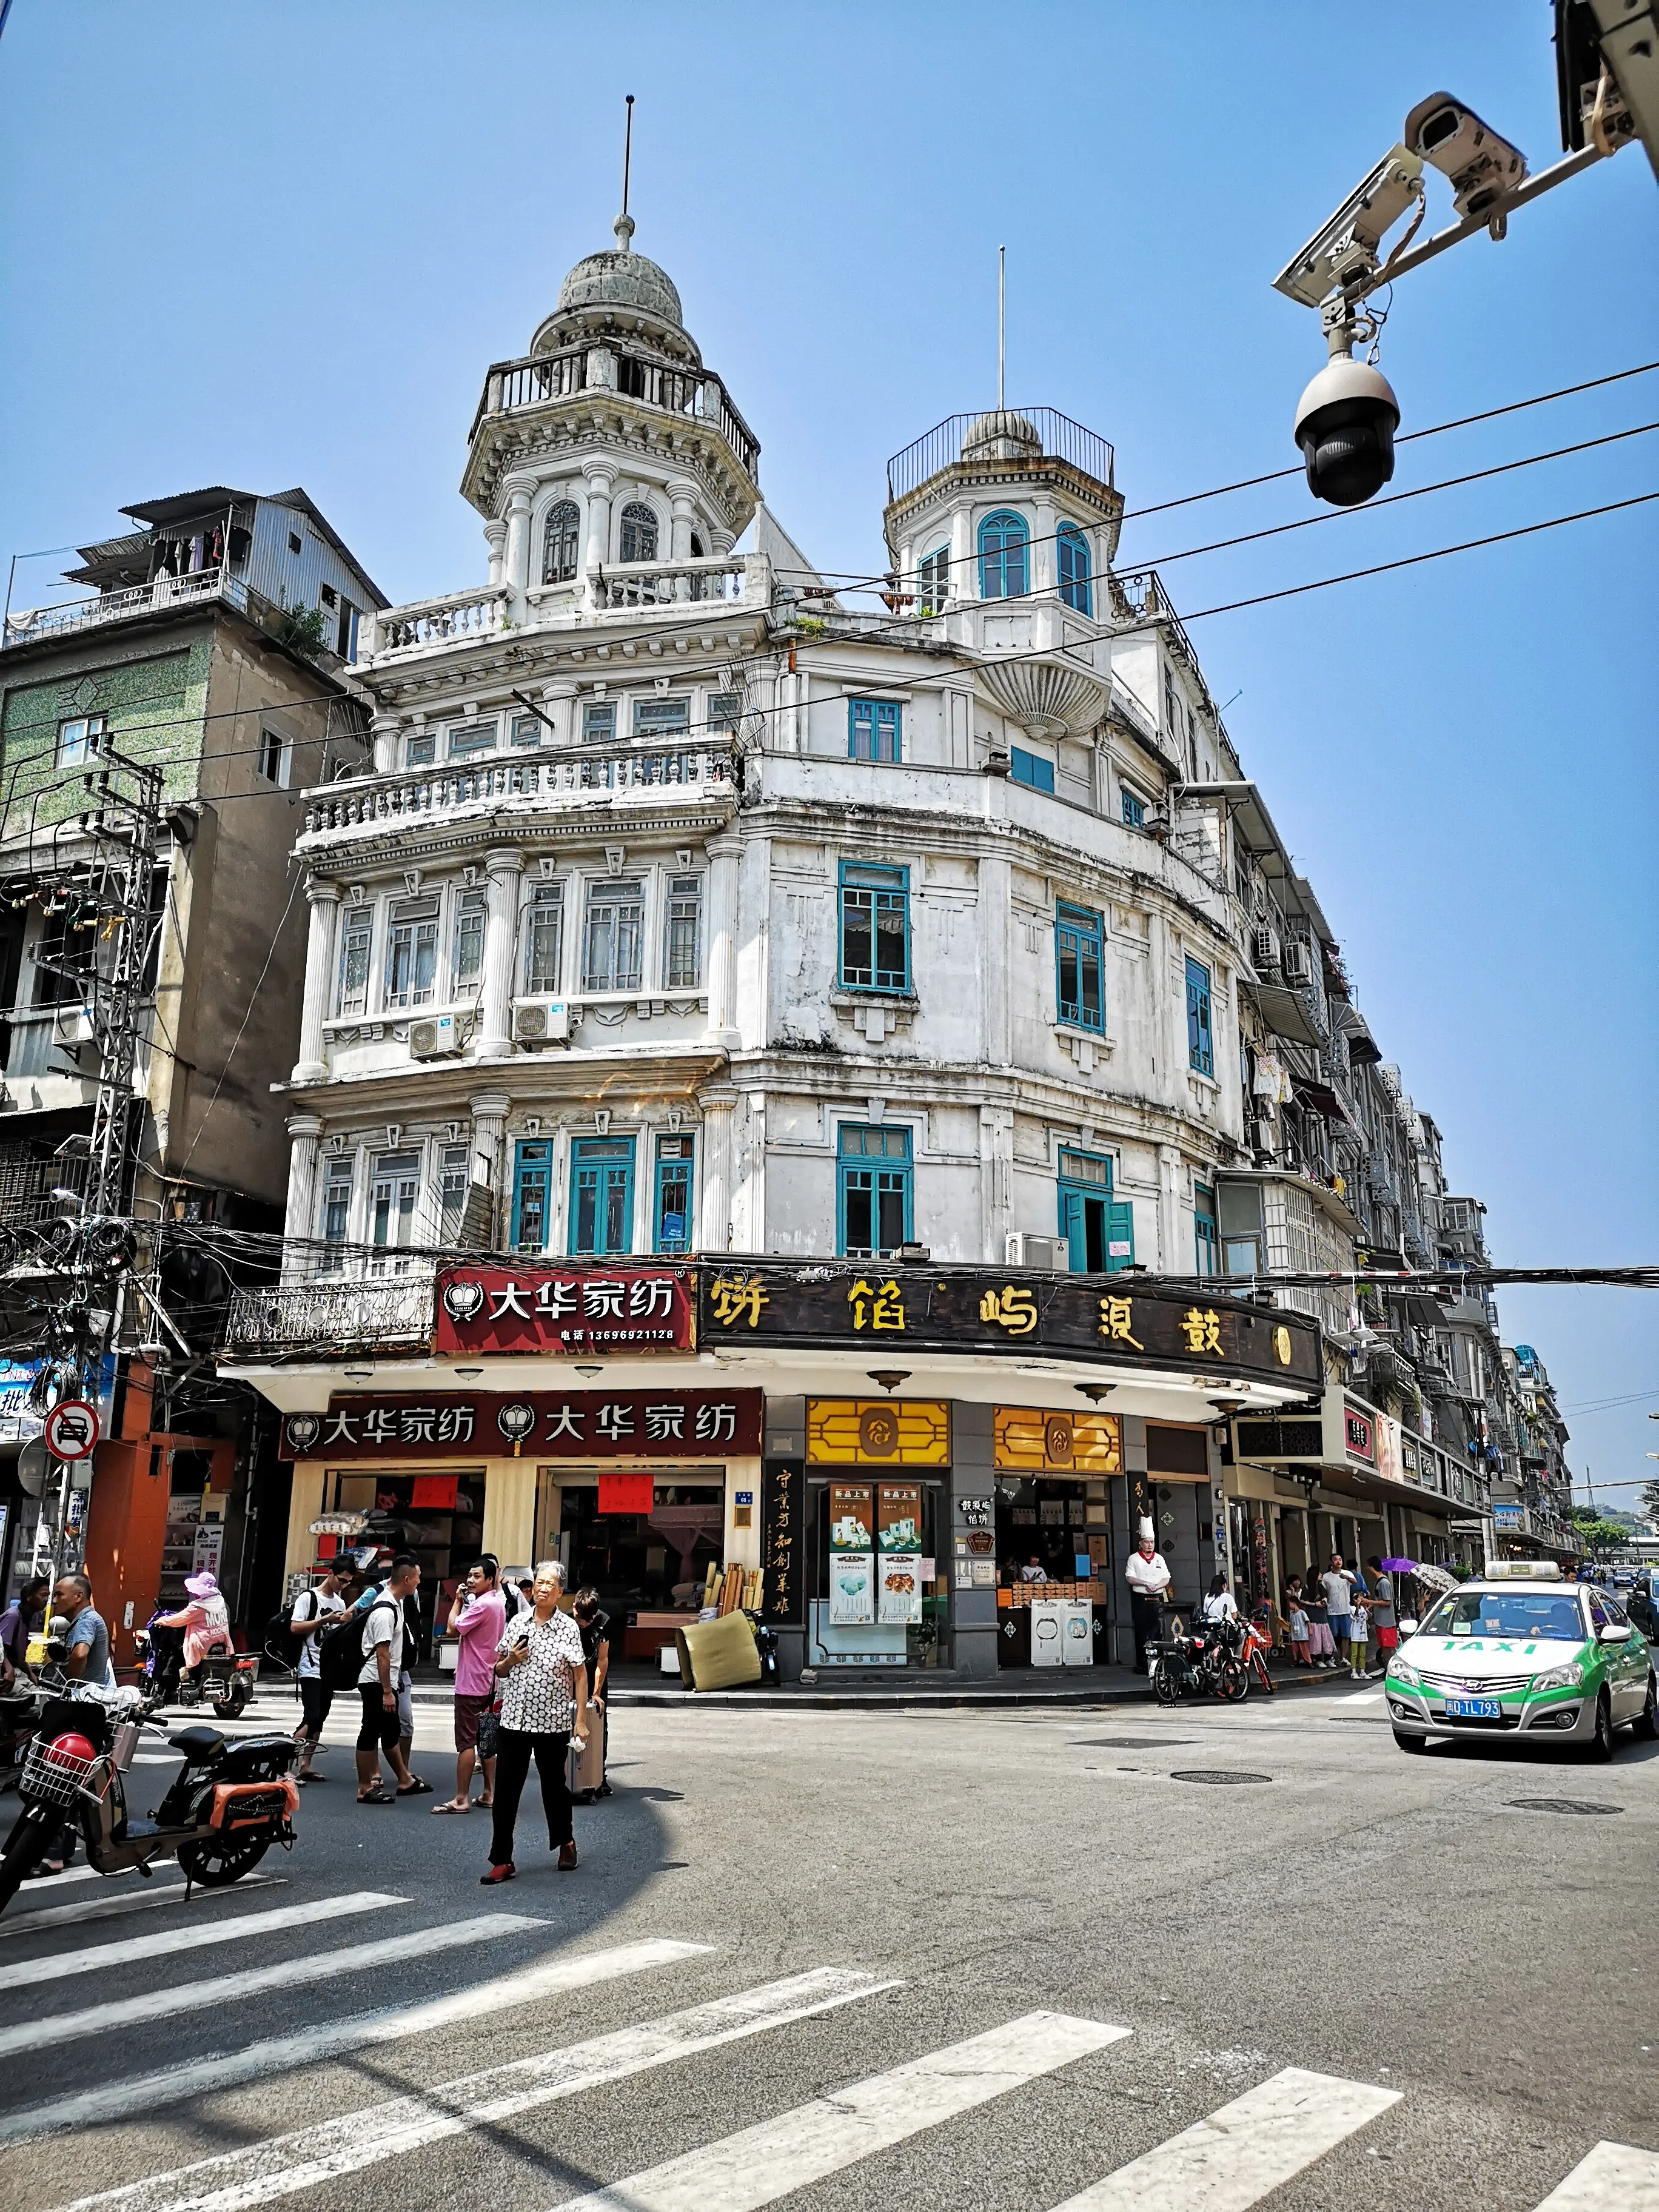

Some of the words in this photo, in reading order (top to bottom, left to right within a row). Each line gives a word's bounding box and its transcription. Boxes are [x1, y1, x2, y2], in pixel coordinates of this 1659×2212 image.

[488, 1279, 674, 1321] 大华家纺
[561, 1330, 583, 1341] 电话
[589, 1330, 674, 1341] 13696921128
[324, 1406, 474, 1445] 大华家纺
[546, 1404, 736, 1441] 大华家纺
[961, 1500, 991, 1511] 鼓浪屿
[968, 1513, 988, 1525] 馅饼
[1442, 1641, 1538, 1655] TAXI
